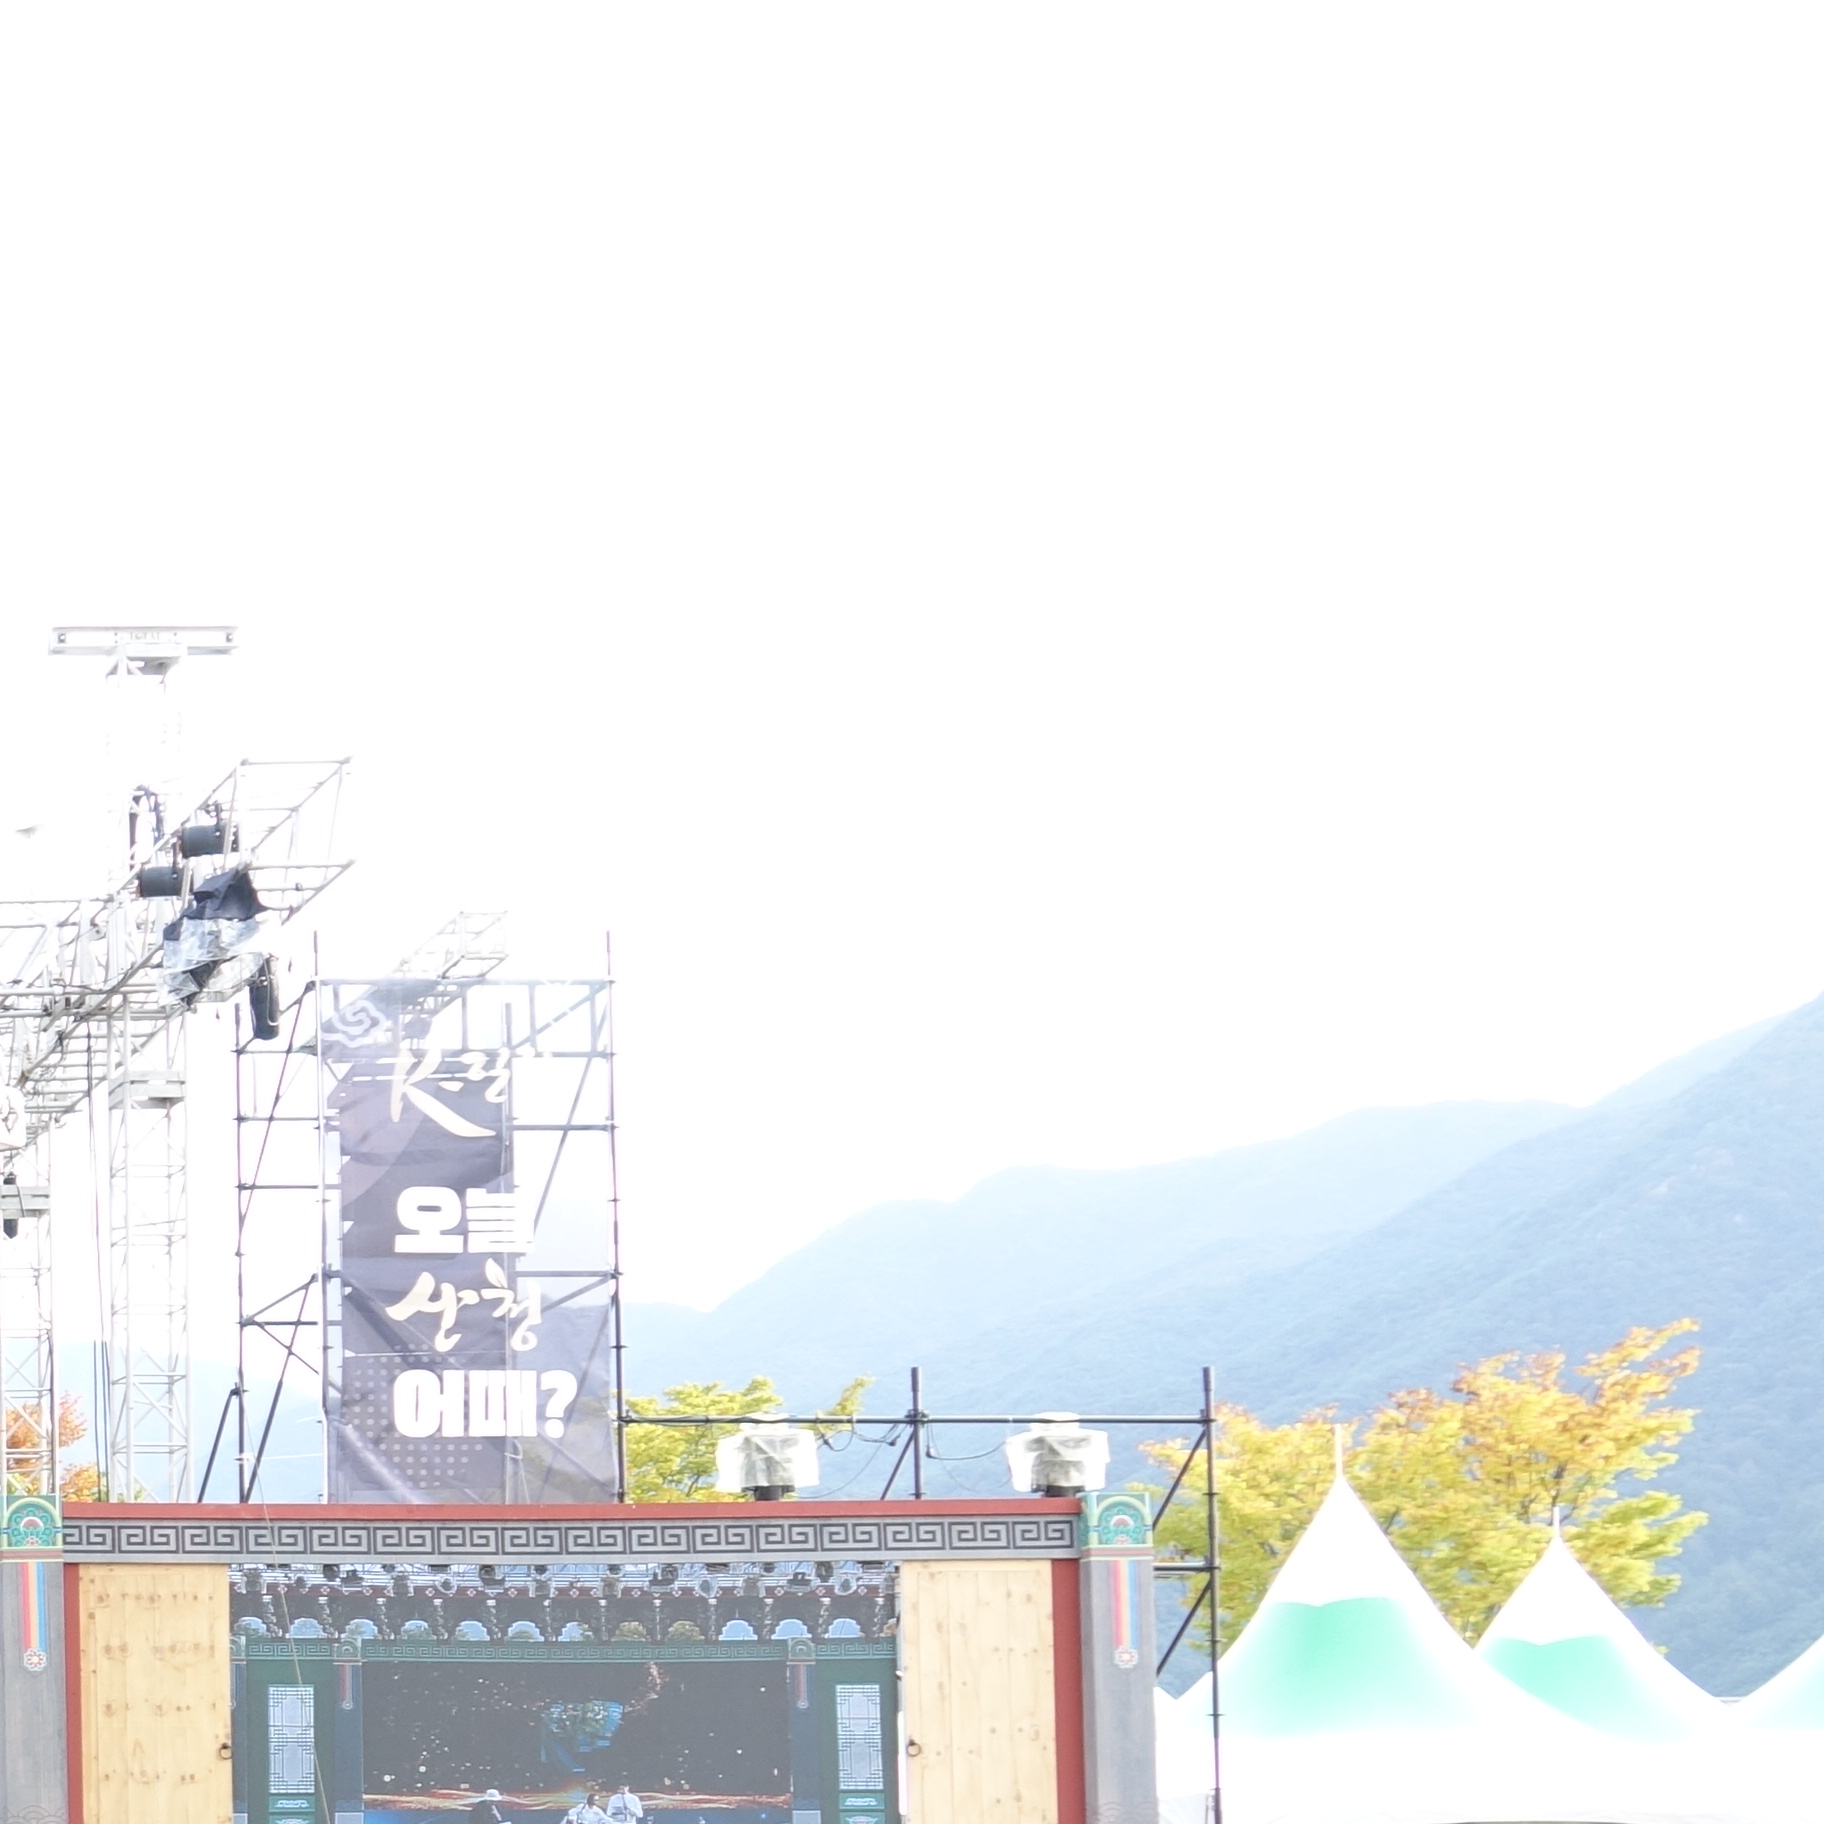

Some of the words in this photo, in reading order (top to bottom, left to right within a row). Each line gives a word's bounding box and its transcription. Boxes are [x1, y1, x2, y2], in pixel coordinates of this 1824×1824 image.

[393, 1185, 537, 1255] 오늘
[386, 1257, 543, 1352] 산청
[392, 1368, 579, 1439] 어때?
